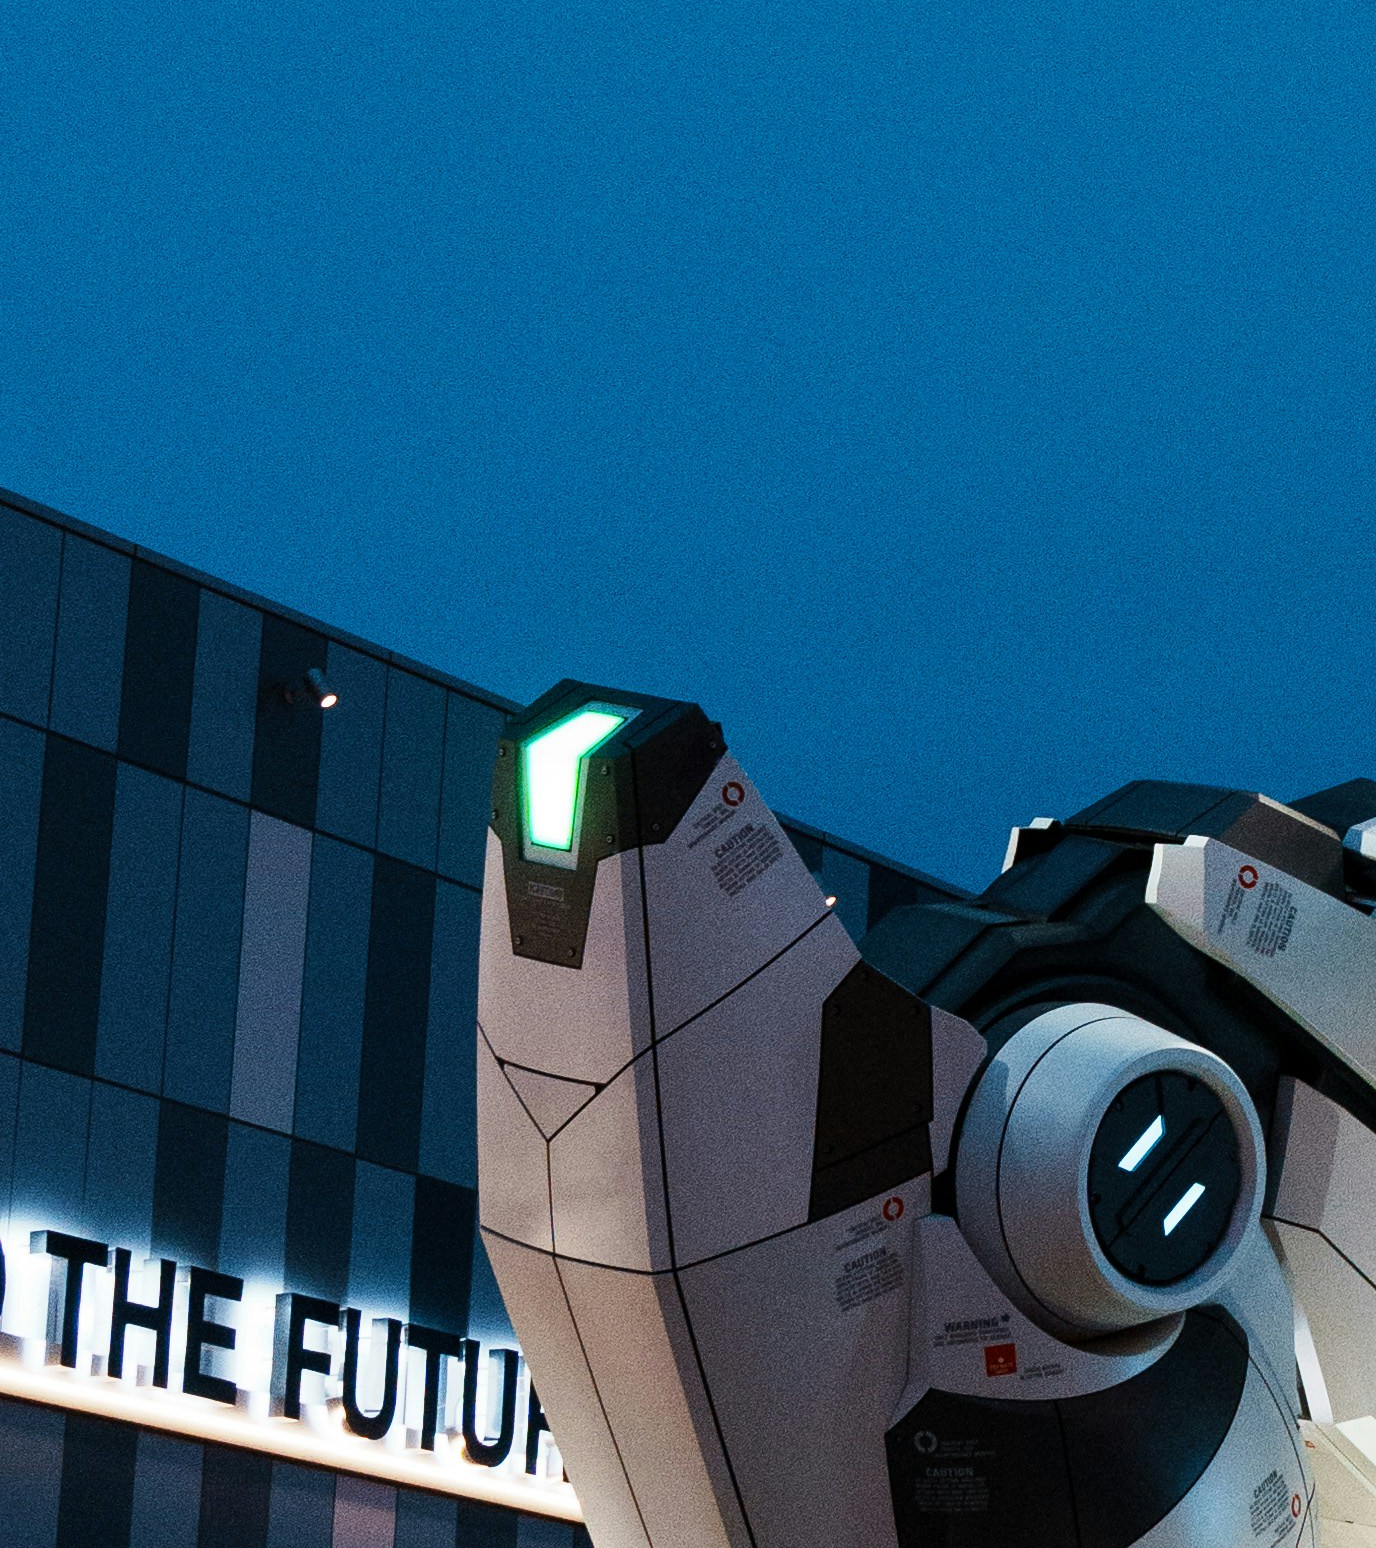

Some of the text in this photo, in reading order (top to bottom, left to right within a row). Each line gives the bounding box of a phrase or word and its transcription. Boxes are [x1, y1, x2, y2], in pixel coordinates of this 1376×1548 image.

[712, 822, 755, 859] CAUTION
[1277, 905, 1298, 952] CAUTION
[843, 1246, 887, 1273] CAUTION
[28, 1229, 245, 1406] THE
[944, 1316, 999, 1333] WARNING
[1253, 1468, 1278, 1499] CAUTION
